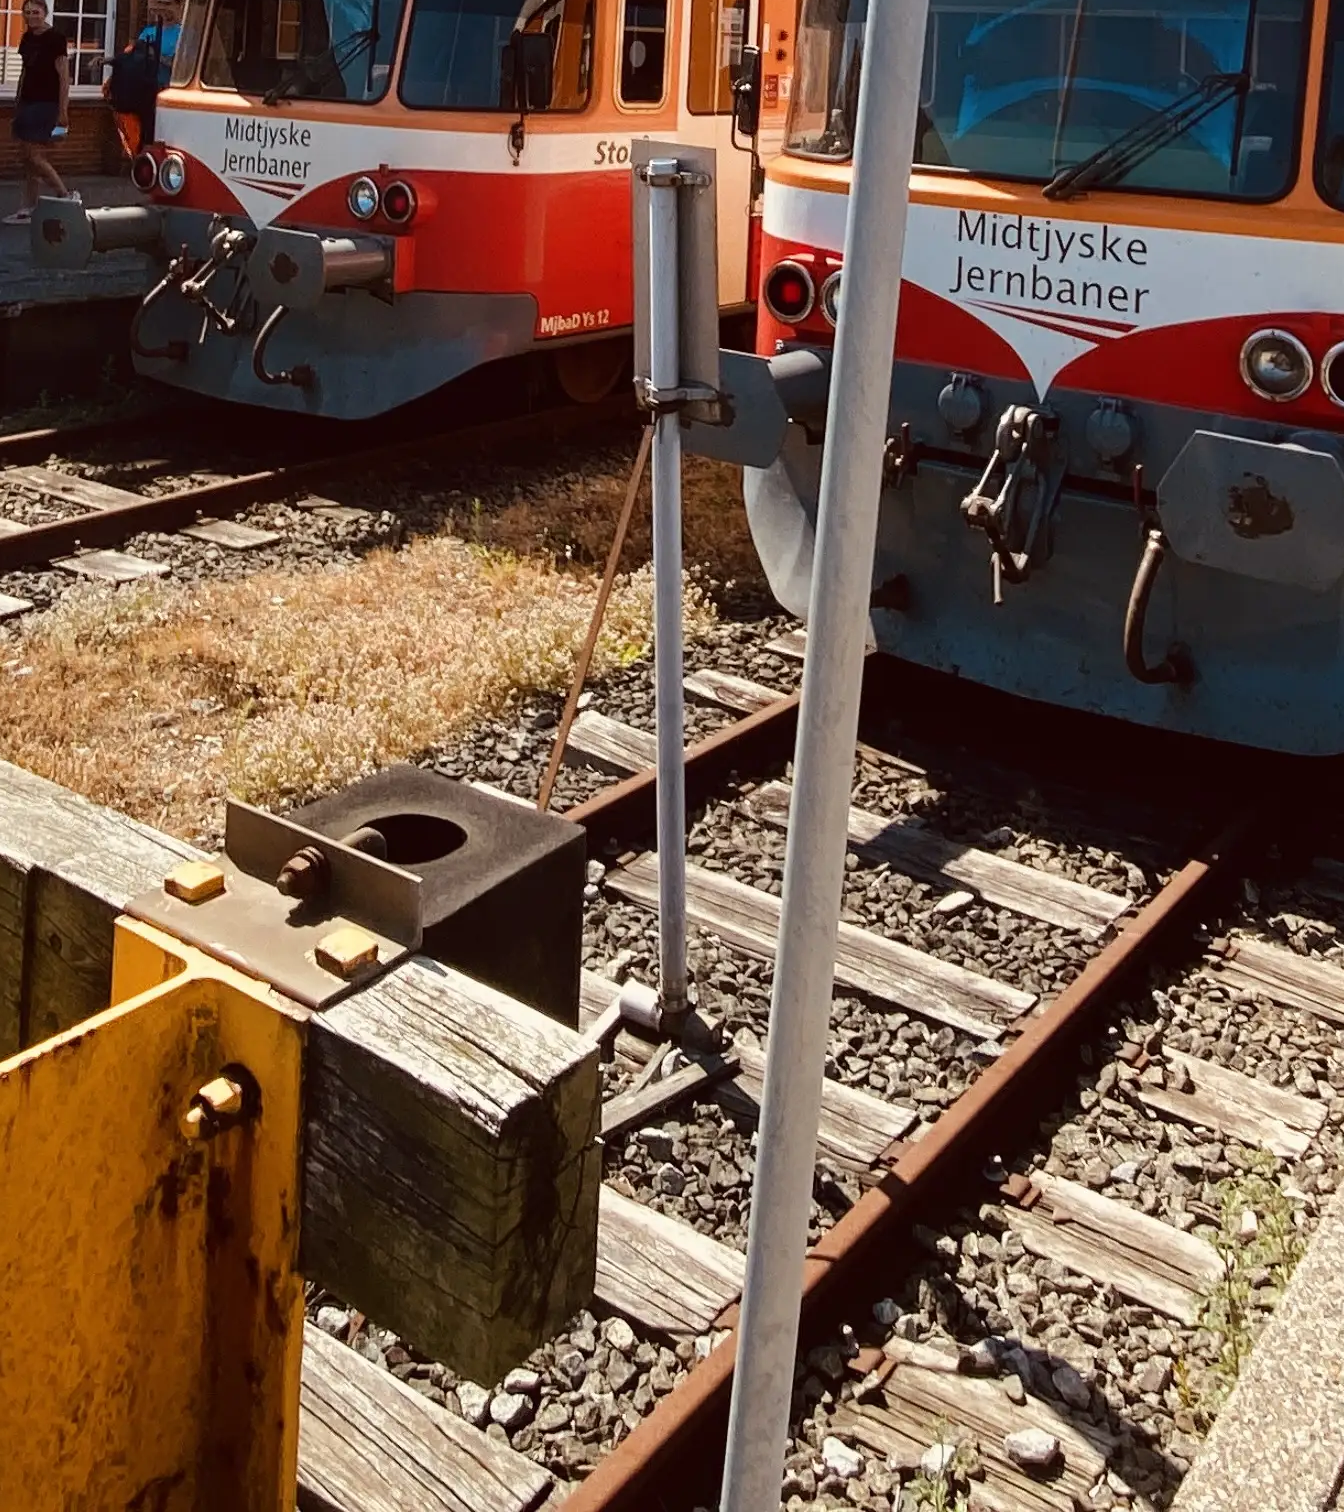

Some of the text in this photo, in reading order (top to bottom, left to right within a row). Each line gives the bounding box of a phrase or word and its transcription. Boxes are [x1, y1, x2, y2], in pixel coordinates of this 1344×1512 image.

[225, 117, 311, 149] Midtjyske
[220, 148, 311, 179] Jernbaner
[594, 140, 631, 165] Sto
[957, 210, 1148, 265] Midtjyske
[949, 256, 1150, 314] Jernbaner
[597, 309, 610, 324] 12
